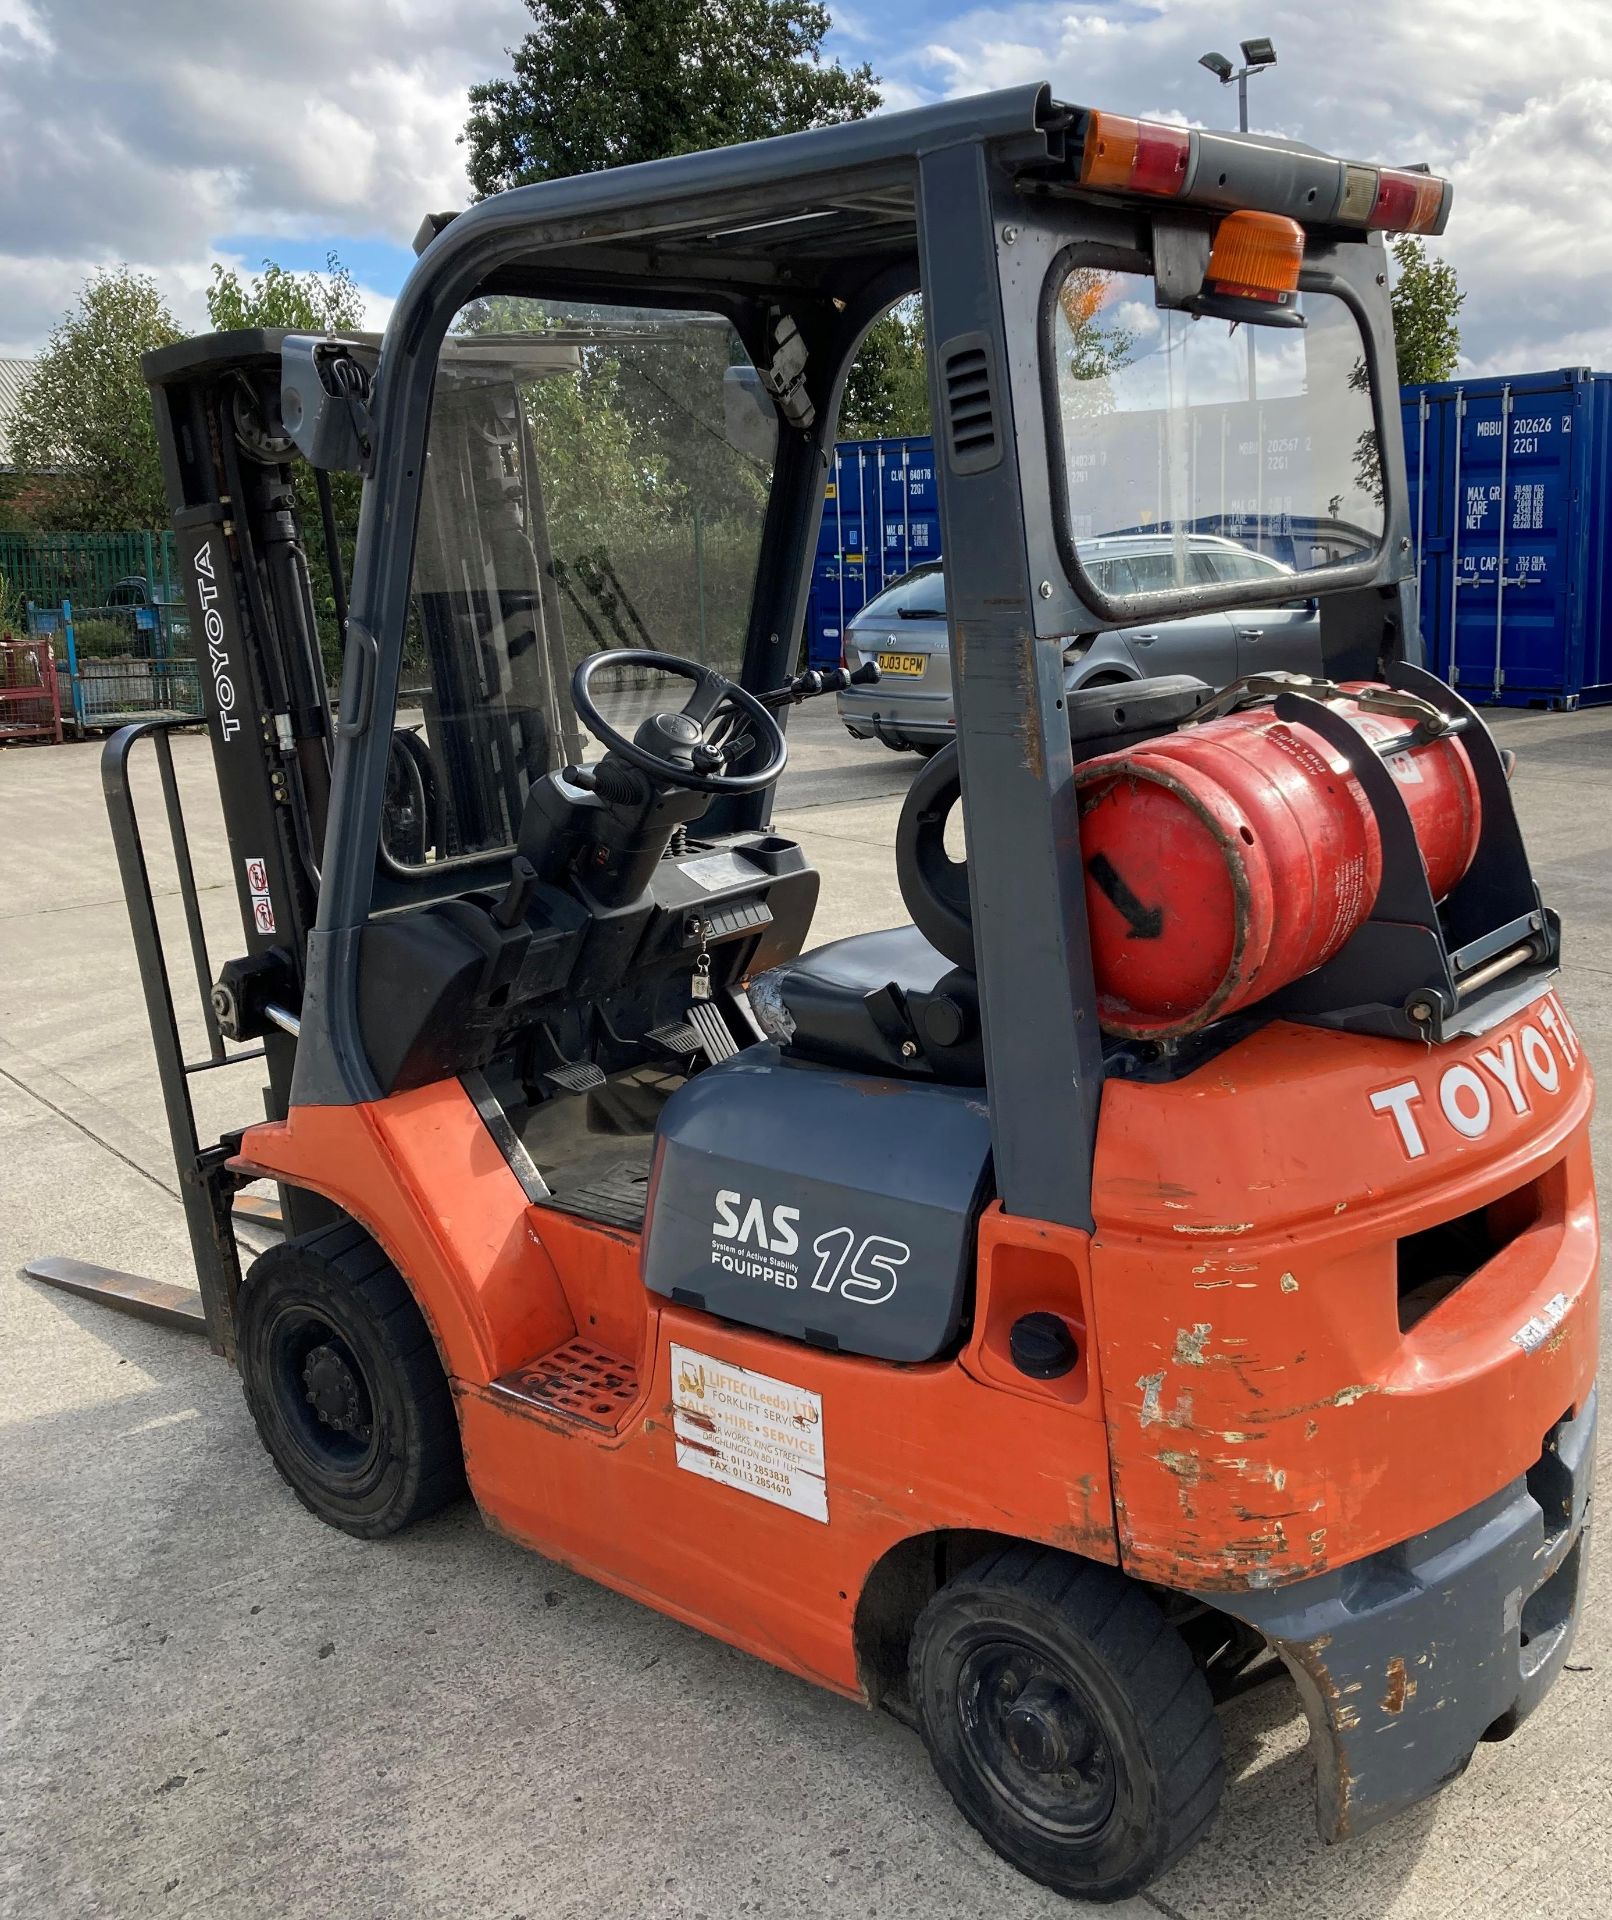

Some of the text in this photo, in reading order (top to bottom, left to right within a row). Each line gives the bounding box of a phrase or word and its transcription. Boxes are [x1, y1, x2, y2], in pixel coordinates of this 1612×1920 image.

[1477, 416, 1571, 437] MBBU 202626 2
[1513, 438, 1538, 454] 22G1
[1267, 456, 1288, 470] 22G1
[1467, 500, 1488, 515] TARE
[1466, 514, 1482, 530] NET
[194, 540, 242, 742] TOYOTA
[1369, 992, 1579, 1159] TOYOTA
[712, 1189, 800, 1256] SAS
[712, 1240, 799, 1274] System of Active Stability
[810, 1226, 910, 1305] 15
[709, 1371, 750, 1396] LIFTEC
[712, 1390, 760, 1416] FORKLIFT
[724, 1412, 754, 1432] HIRE
[762, 1426, 816, 1455] SERVICE
[754, 1440, 773, 1455] KING
[710, 1458, 792, 1497] FAX: 0113 2854670
[730, 1455, 751, 1470] 0113
[754, 1464, 790, 1485] 2853838
